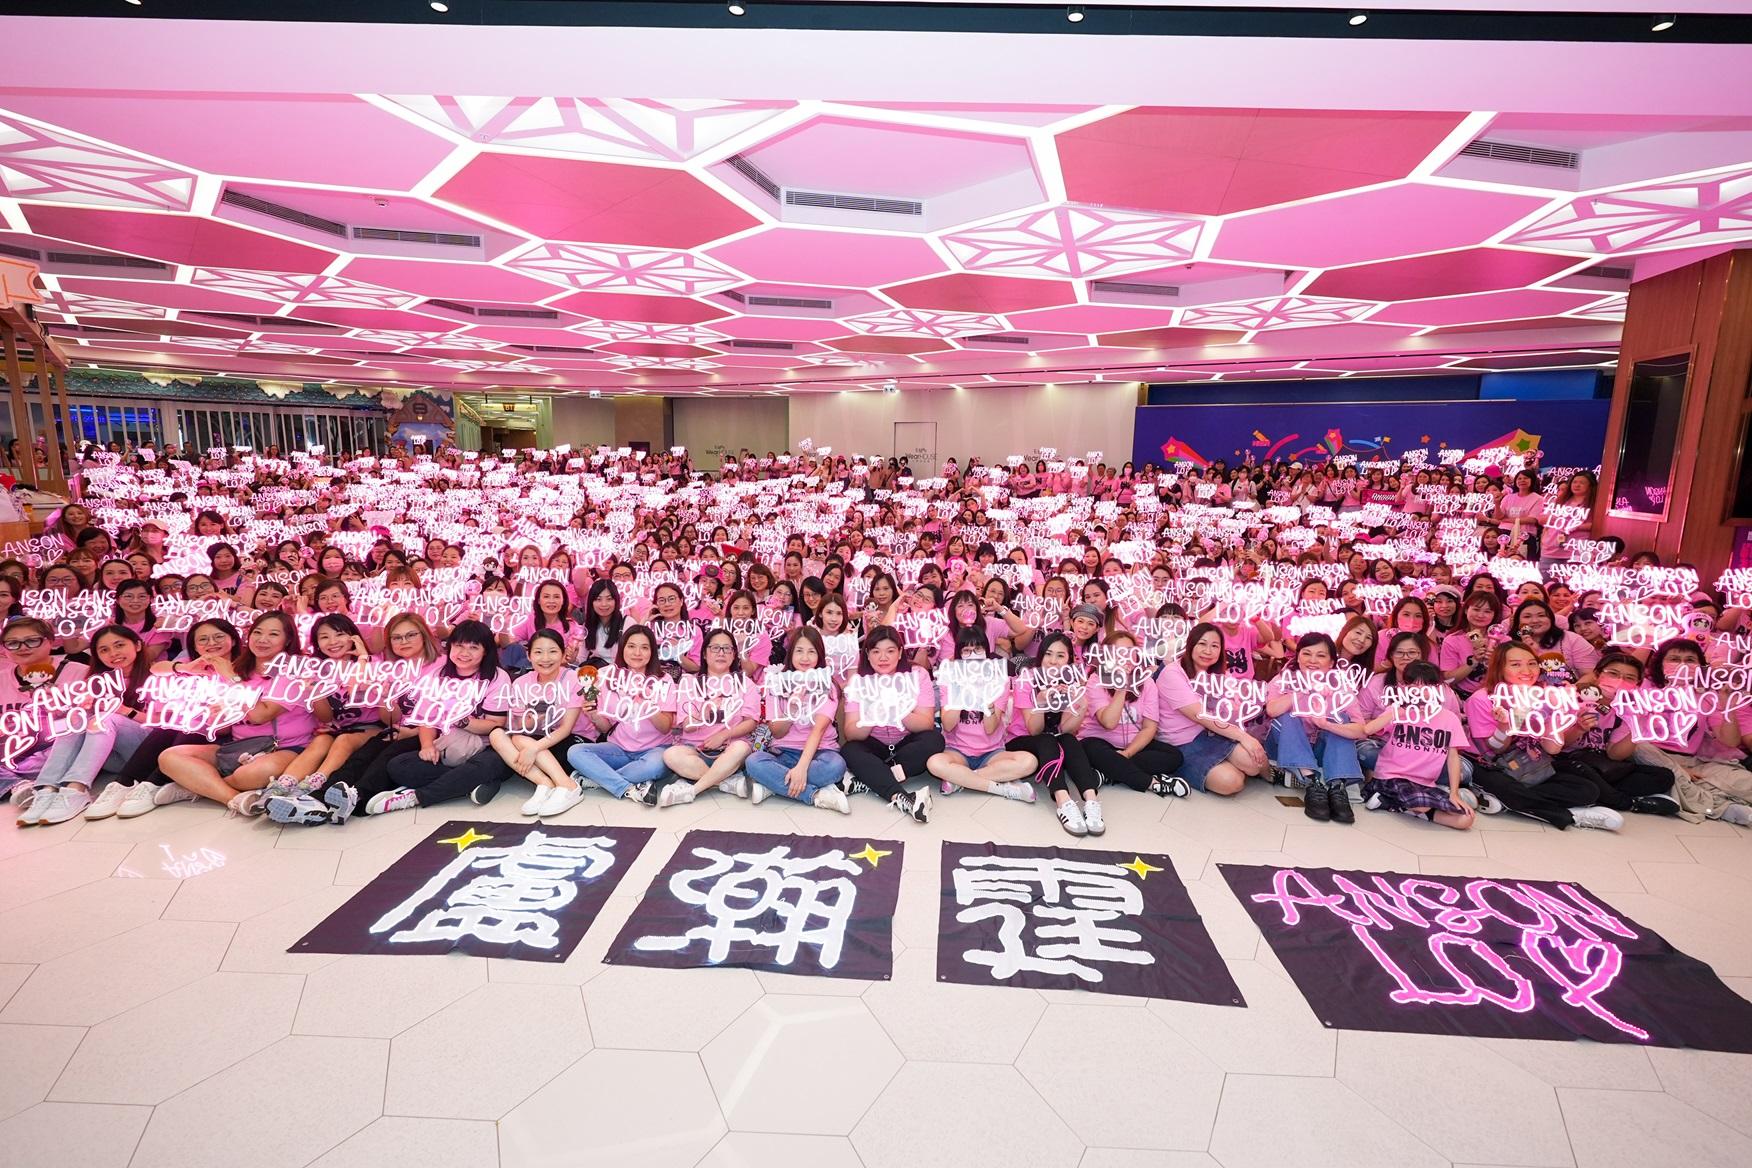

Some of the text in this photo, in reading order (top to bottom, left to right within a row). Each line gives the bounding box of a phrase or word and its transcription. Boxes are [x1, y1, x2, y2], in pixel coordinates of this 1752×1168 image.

[1544, 502, 1590, 520] ANSON
[1545, 515, 1565, 530] LO
[960, 526, 989, 535] ANSON
[1162, 528, 1193, 537] ANSON
[1440, 518, 1477, 528] ANSON
[1, 533, 64, 558] ANSON
[751, 541, 786, 553] ANSON
[1563, 538, 1616, 553] ANSON
[576, 551, 596, 568] LO
[870, 555, 896, 568] NSON
[1567, 551, 1592, 564] LO
[252, 568, 310, 588] ANSON
[517, 566, 569, 583] ANSON
[636, 571, 678, 583] ANSON
[1304, 563, 1349, 577] ANSON
[1452, 564, 1471, 576] LO
[1641, 565, 1700, 583] ANSON
[72, 588, 117, 606] ANS
[1163, 580, 1216, 598] ANSON
[1353, 584, 1403, 599] ANSON
[471, 594, 533, 613] ANSON
[1012, 593, 1062, 612] ANSON
[1212, 602, 1241, 623] LO
[1297, 598, 1345, 614] ANSON
[1364, 599, 1386, 615] LO
[157, 615, 193, 632] LO
[355, 606, 381, 625] LO
[707, 617, 765, 635] ANSON
[894, 608, 950, 629] ANSON
[1593, 603, 1684, 626] ANSON
[1134, 618, 1198, 637] ANSON
[1607, 624, 1646, 647] LO
[264, 652, 347, 680] ANSON
[1083, 642, 1156, 668] ANSON
[342, 658, 424, 680] ANSON
[934, 659, 1010, 683] ANSON
[1017, 665, 1088, 690] ANSON
[1095, 666, 1128, 689] LO
[1276, 669, 1361, 692] ANSON
[1666, 664, 1752, 691] ANSO
[25, 668, 126, 716] ANSON
[262, 675, 302, 702] LO
[408, 677, 490, 703] ANSON
[598, 664, 669, 704] ANSON
[672, 671, 750, 702] ANSON
[756, 669, 832, 697] ANSON
[843, 672, 921, 702] ANSON
[1189, 671, 1267, 703] ANSON
[344, 682, 382, 708] LO
[493, 681, 572, 709] ANSON
[599, 690, 632, 722] LO
[943, 682, 979, 712] LO
[1031, 687, 1062, 713] LO
[1290, 692, 1326, 718] LO
[1379, 685, 1445, 706] ANSON
[1487, 683, 1580, 712] ANSON
[1611, 686, 1701, 717] ANSON
[403, 700, 441, 726] LO
[684, 701, 718, 728] LO
[770, 696, 803, 723] LO
[855, 699, 892, 729] LO
[1196, 695, 1233, 722] LO
[1391, 705, 1422, 725] LO
[46, 708, 88, 741] LO
[504, 708, 539, 735] LO
[1505, 708, 1546, 738] LO
[1631, 714, 1670, 743] LO
[1249, 868, 1639, 942] ANSON
[1352, 923, 1534, 1014] LO
